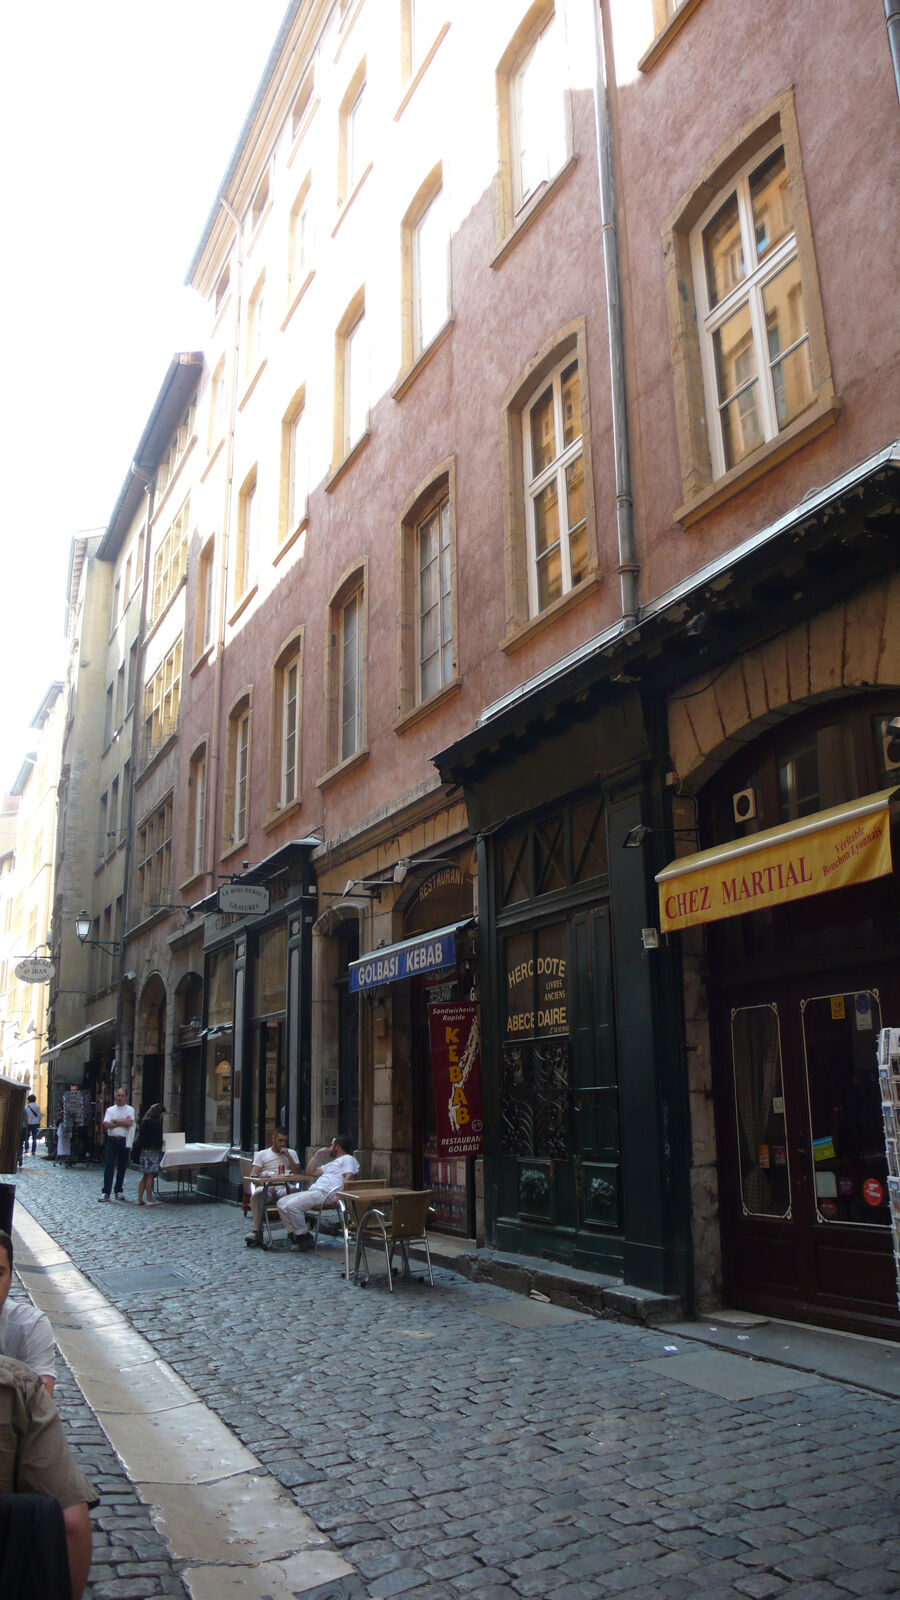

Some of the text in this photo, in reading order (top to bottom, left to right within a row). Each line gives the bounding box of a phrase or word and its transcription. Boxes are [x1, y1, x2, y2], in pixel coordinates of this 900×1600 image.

[834, 826, 864, 853] Véritable
[823, 826, 883, 877] Bouchon Lyonnais
[665, 857, 813, 919] CHEZ MARTIAL
[229, 902, 259, 911] GRAVURES
[358, 942, 443, 986] GOLBASI KEBAB
[546, 980, 562, 990] LIVRES
[544, 990, 566, 1001] ANCIENS
[432, 1006, 475, 1015] Sandwicherie
[448, 1144, 480, 1153] GOLBASI
